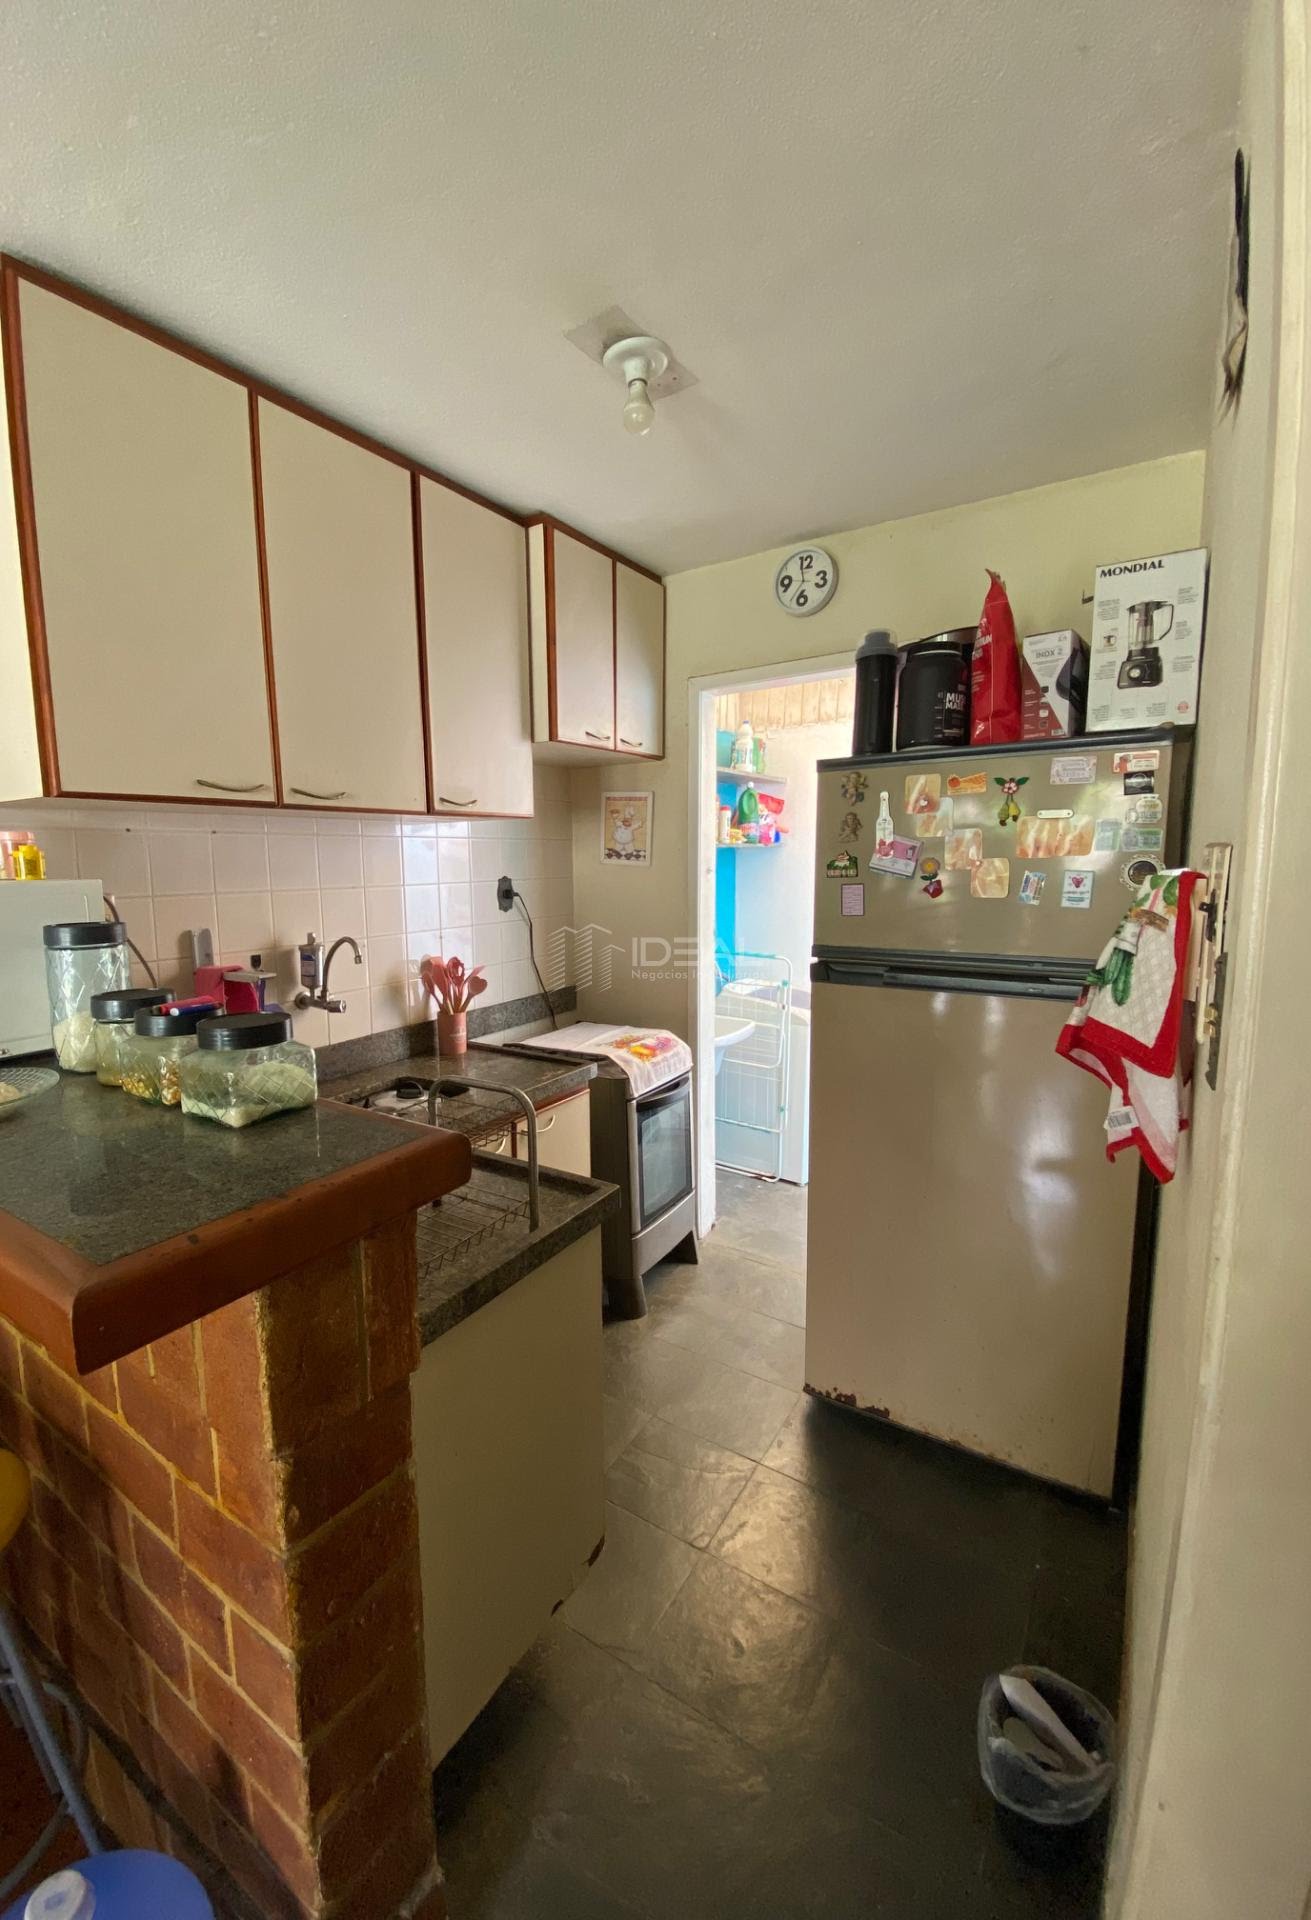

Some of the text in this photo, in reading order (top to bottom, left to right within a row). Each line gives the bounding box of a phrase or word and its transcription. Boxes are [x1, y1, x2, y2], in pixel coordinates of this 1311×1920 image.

[799, 554, 814, 570] 12
[1100, 559, 1165, 578] MONDIAL
[780, 575, 793, 593] 9
[814, 570, 828, 589] 3
[796, 589, 808, 607] 6
